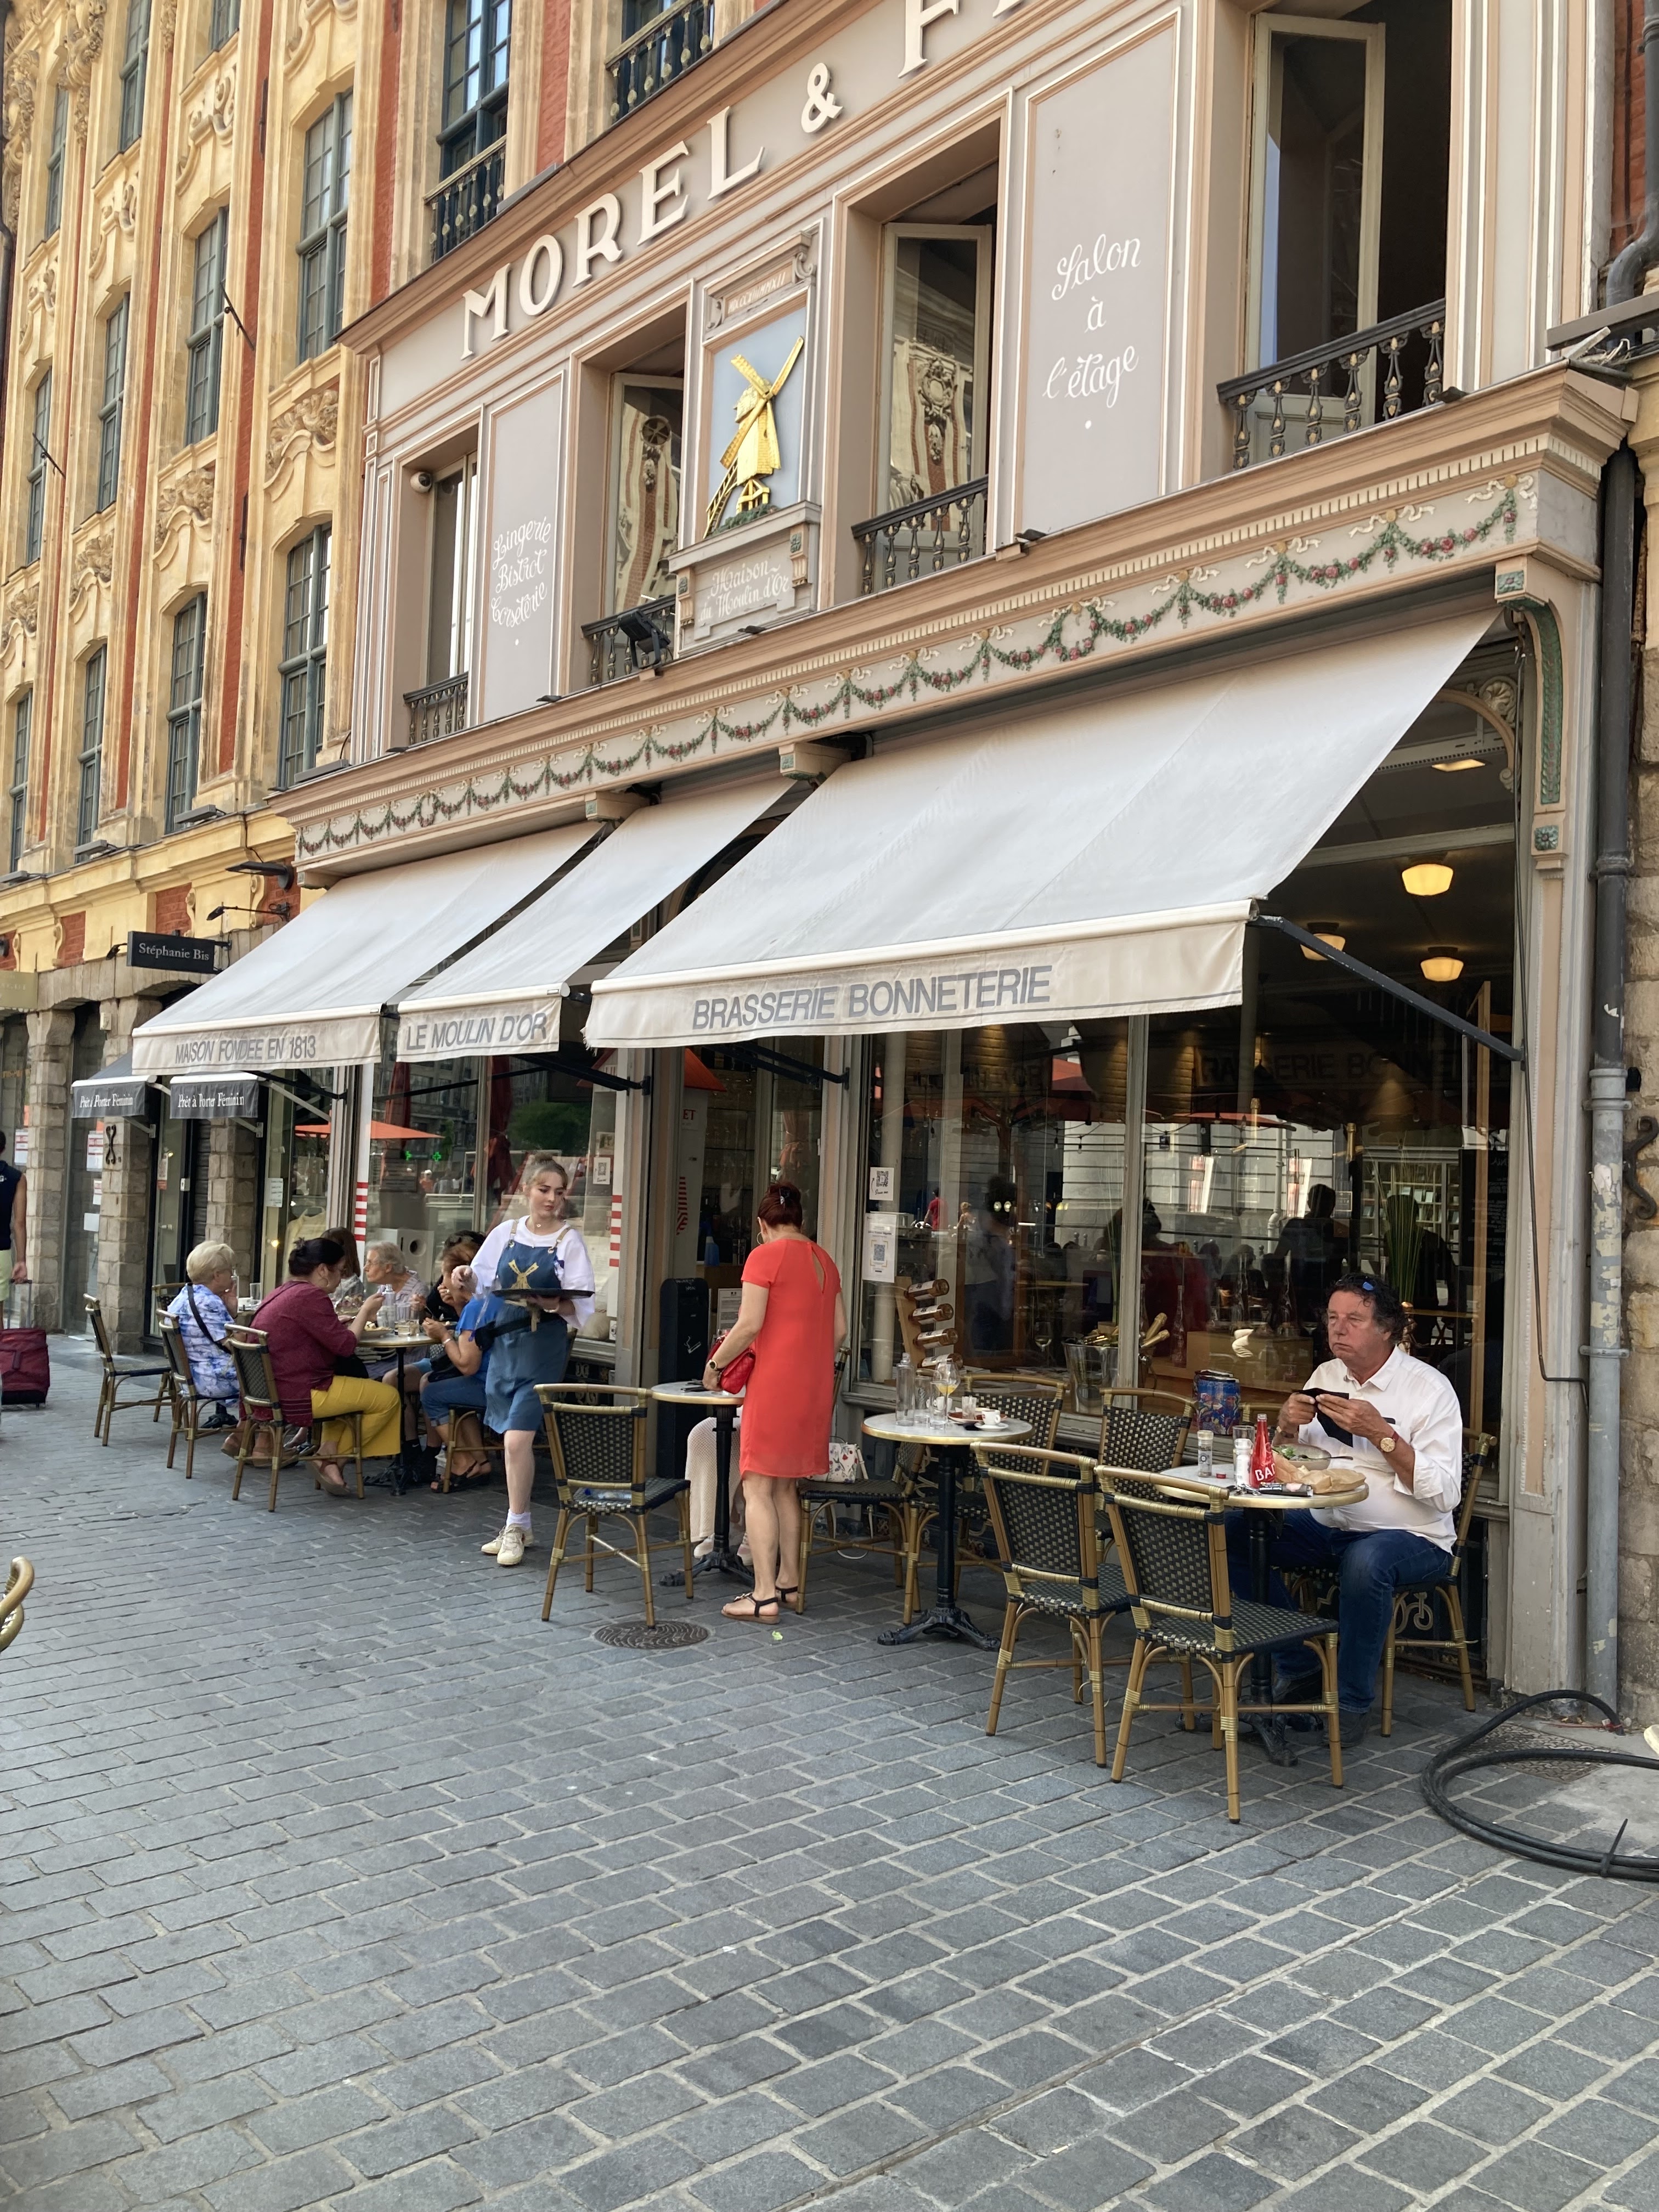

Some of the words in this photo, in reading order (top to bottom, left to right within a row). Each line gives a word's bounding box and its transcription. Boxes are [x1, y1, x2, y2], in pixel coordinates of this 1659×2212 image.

[460, 106, 765, 360] MOREL
[800, 62, 844, 133] &
[1052, 234, 1141, 300] Salon
[1084, 296, 1106, 333] à
[1042, 346, 1139, 408] l'étage
[492, 516, 551, 570] Lingerie
[495, 549, 547, 593] Bistrot
[709, 560, 769, 597] Maison
[491, 582, 548, 628] Corseterie
[698, 600, 712, 621] du
[716, 584, 760, 618] Moulin
[763, 573, 790, 597] d'Or
[139, 943, 190, 958] Stéphanie
[193, 949, 210, 961] Bis
[692, 986, 839, 1030] BRASSERIE
[848, 966, 1052, 1017] BONNETERIE
[175, 1041, 215, 1064] MAISON
[218, 1039, 264, 1062] FONDEE
[268, 1037, 285, 1060] EN
[289, 1035, 315, 1059] 1813
[407, 1025, 427, 1050] LE
[431, 1017, 496, 1048] MOULIN
[500, 1012, 547, 1042] D'OR
[94, 1094, 111, 1107] Porter
[112, 1093, 133, 1107] Féminin
[177, 1094, 191, 1108] Prêt
[192, 1092, 196, 1107] à
[198, 1093, 216, 1108] Porter
[217, 1092, 245, 1107] Féminin
